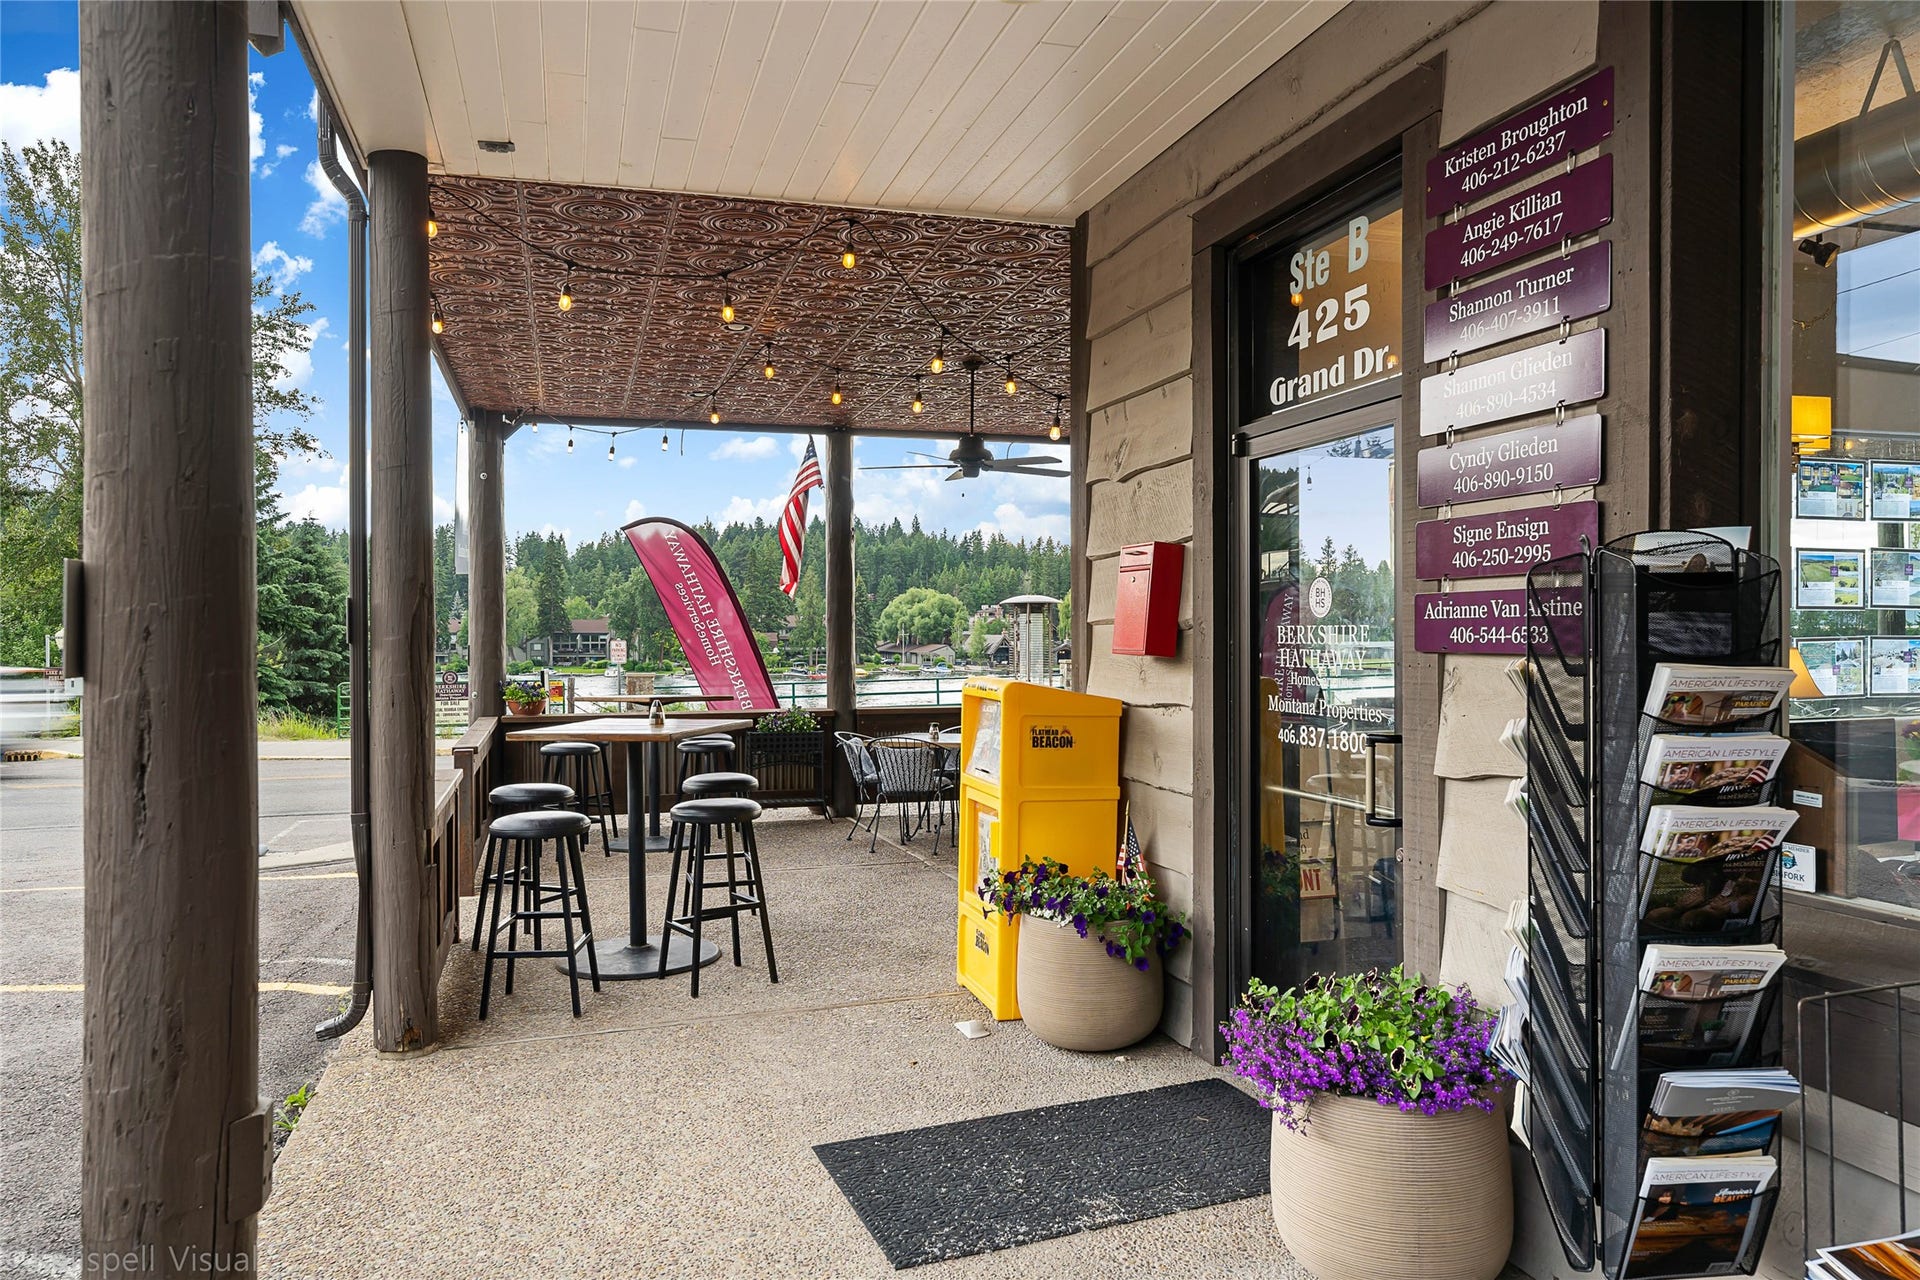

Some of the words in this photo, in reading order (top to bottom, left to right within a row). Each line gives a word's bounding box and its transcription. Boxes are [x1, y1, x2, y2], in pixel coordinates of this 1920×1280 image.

[1444, 142, 1497, 178] Kristen
[1501, 96, 1588, 152] Broughton
[1461, 130, 1566, 193] 406-212-6237
[1462, 212, 1505, 244] Angie
[1508, 189, 1562, 225] Killian
[1460, 212, 1564, 268] 406-249-7617
[1289, 248, 1330, 297] Ste
[1347, 215, 1369, 274] B
[1449, 289, 1512, 323] Shannon
[1516, 265, 1575, 302] Turner
[1287, 283, 1371, 350] 425
[1460, 295, 1560, 343] 406-407-3911
[1269, 355, 1345, 406] Grand
[1443, 371, 1507, 400] Shannon
[1511, 349, 1573, 382] Glieden
[1456, 379, 1557, 420] 406-890-4534
[1450, 446, 1494, 474] Cyndy
[1498, 436, 1558, 463] Glieden
[1453, 462, 1554, 494] 406-890-9150
[1453, 523, 1492, 547] Signe
[1496, 518, 1550, 542] Ensign
[1452, 544, 1551, 569] 406-250-2995
[1424, 600, 1488, 620] Adrianne
[1490, 599, 1520, 618] Van
[1276, 624, 1370, 645] BERKSHIRE
[1450, 625, 1549, 645] 406-544-6533
[1279, 648, 1367, 671] HATHAWAY
[1669, 679, 1725, 689] AMERICAN
[1727, 679, 1785, 688] LIFESTYLE
[1268, 694, 1316, 717] Montana
[1319, 699, 1382, 724] Properties
[1032, 736, 1073, 748] BEACON
[1278, 725, 1367, 755] 406.837.1800
[1664, 749, 1720, 758] AMERICAN
[1722, 749, 1779, 758] LIFESTYLE
[1671, 820, 1727, 829] AMERICAN
[1729, 819, 1787, 828] LIFESTYLE
[1657, 959, 1713, 968] AMERICAN
[1715, 959, 1775, 968] LIFESTYLE
[1652, 1171, 1707, 1181] AMERICAN
[1709, 1171, 1765, 1179] LIFESTYLE
